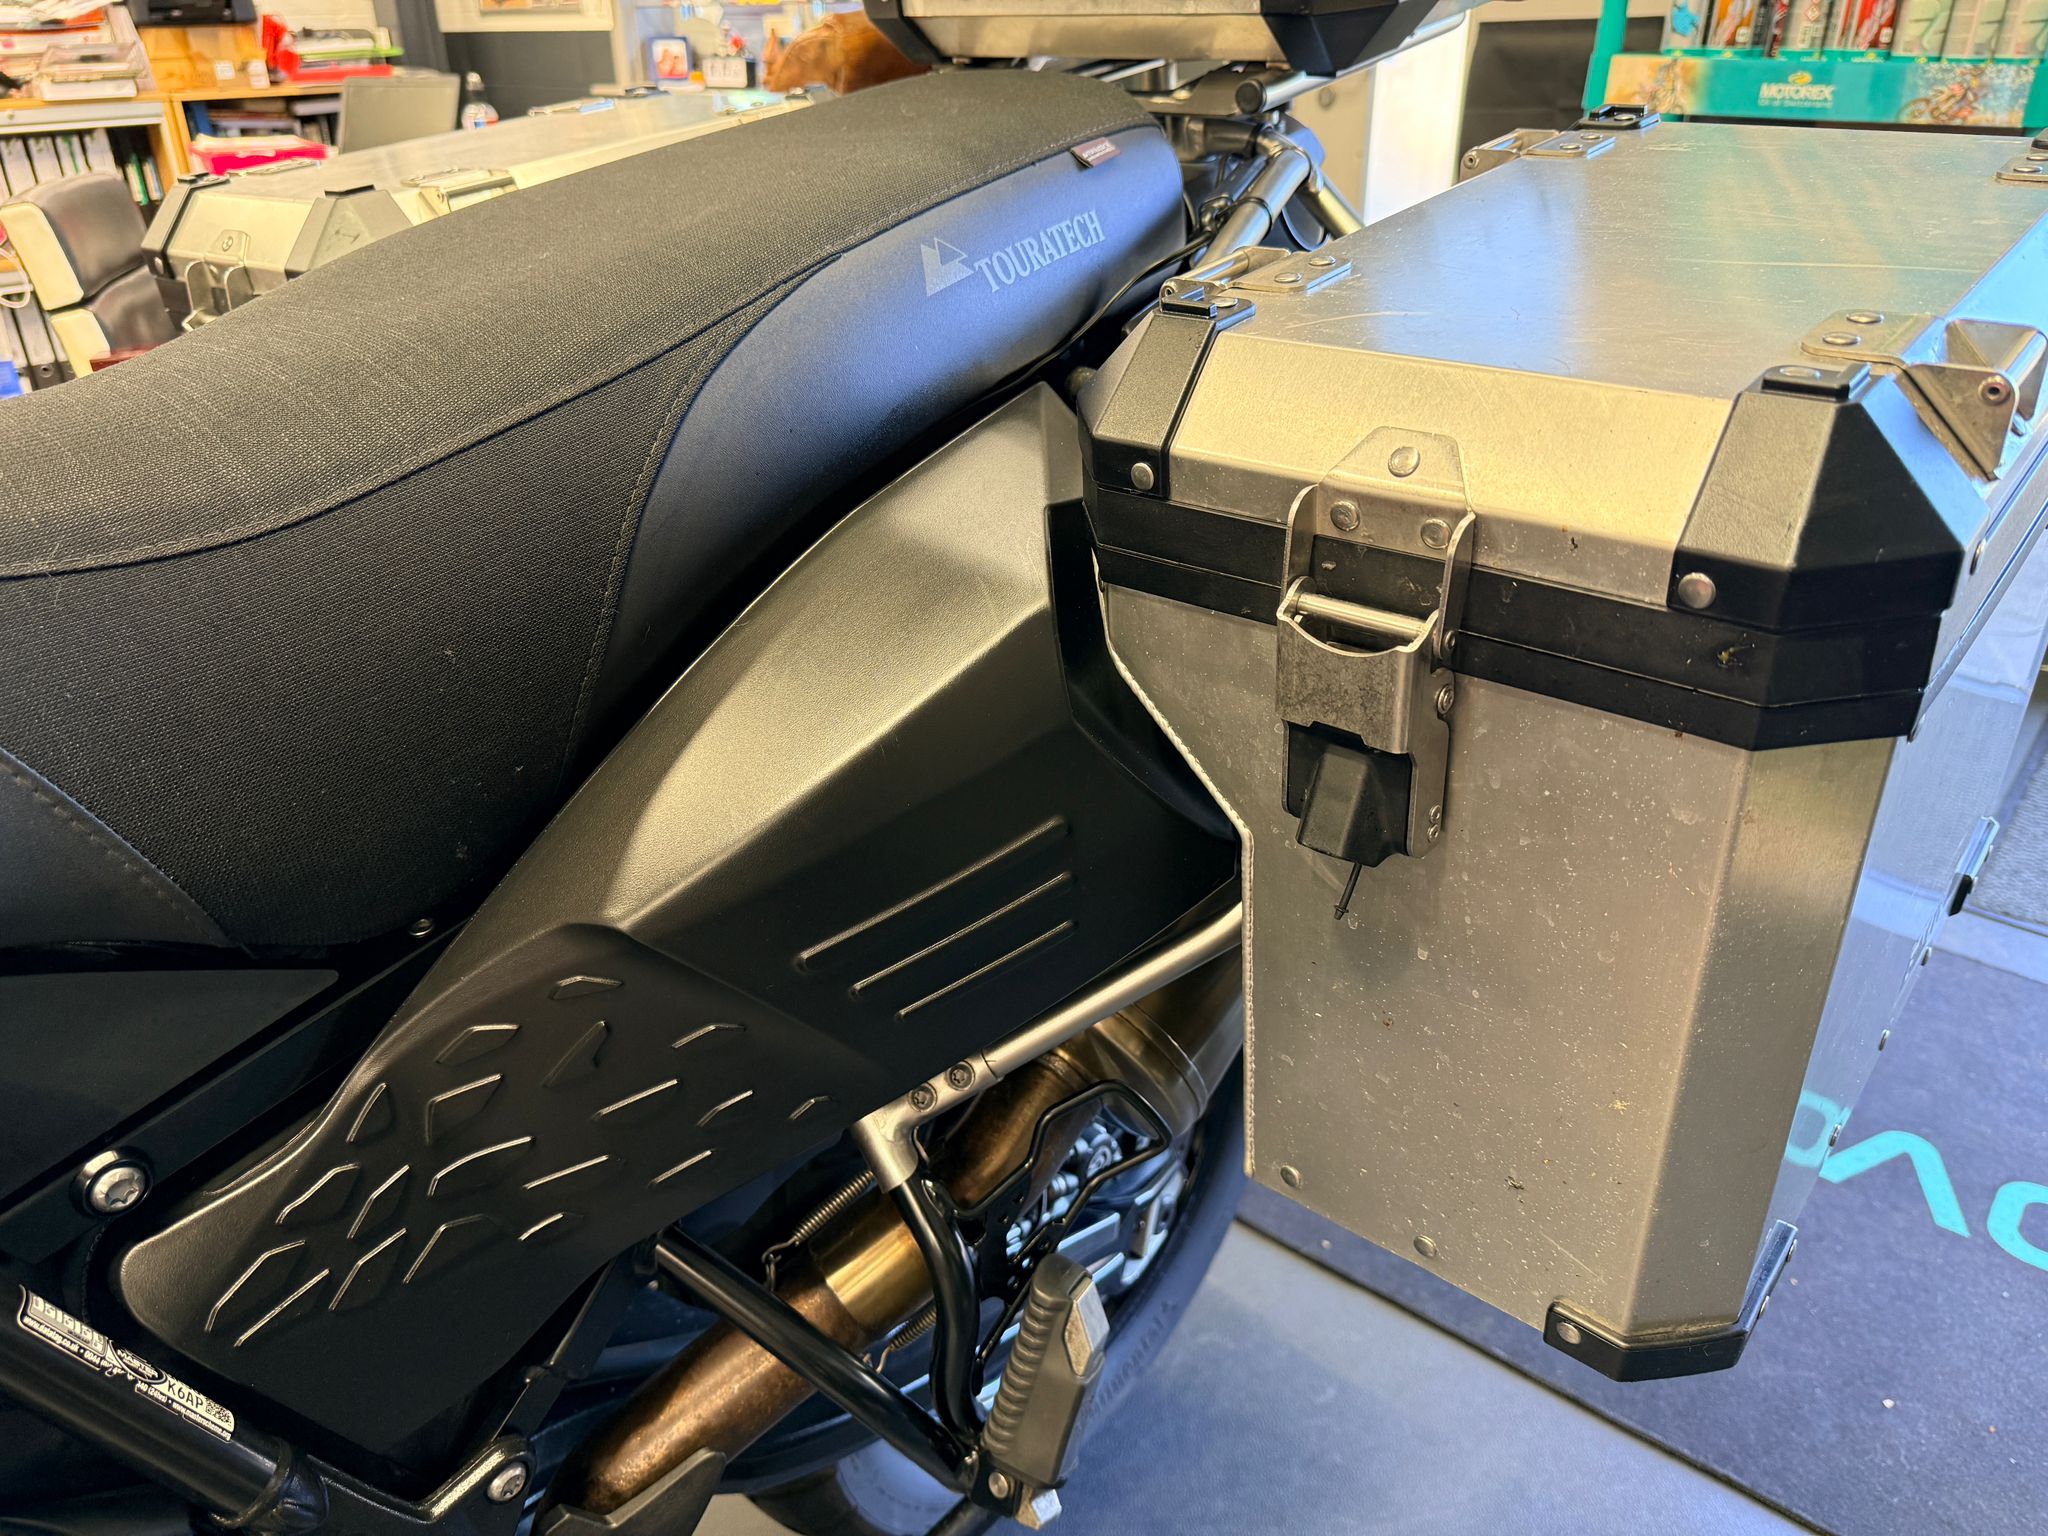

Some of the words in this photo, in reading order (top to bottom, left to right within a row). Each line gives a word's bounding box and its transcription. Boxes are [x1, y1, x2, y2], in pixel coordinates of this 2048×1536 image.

[1758, 82, 1835, 102] MOTOREX
[973, 209, 1106, 293] TOURATECH
[117, 1349, 158, 1378] MASTER
[167, 1380, 204, 1409] K6AP
